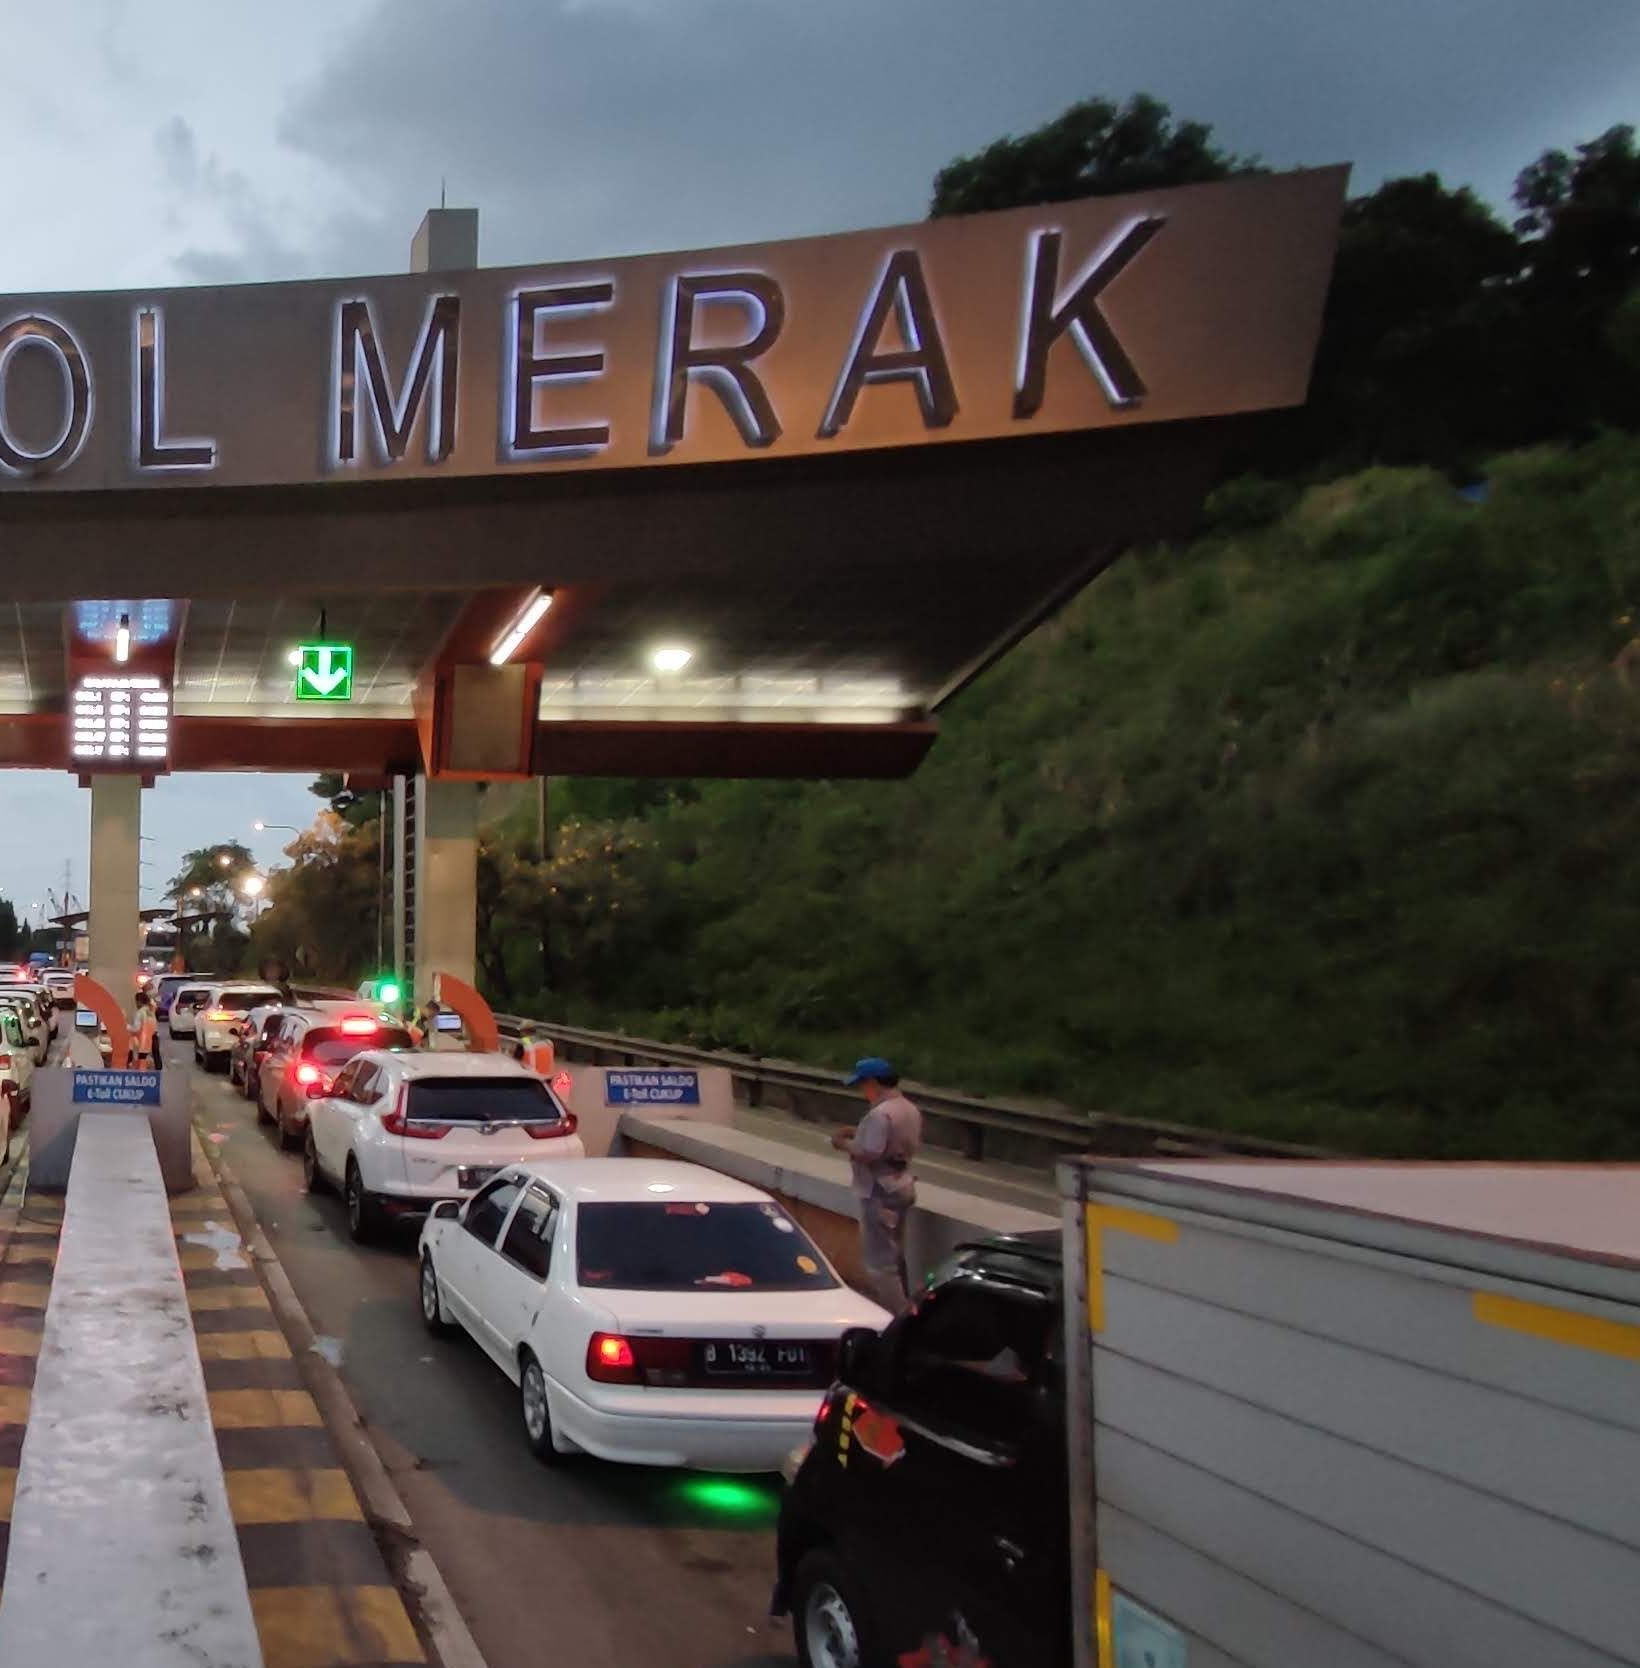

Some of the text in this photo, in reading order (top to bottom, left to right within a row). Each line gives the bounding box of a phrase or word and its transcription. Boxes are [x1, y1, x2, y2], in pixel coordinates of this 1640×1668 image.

[326, 214, 1168, 468] MERAK
[75, 1074, 157, 1088] PASTIKAN SALDO
[609, 1074, 695, 1087] PASTIKAN SALDO
[113, 1088, 145, 1100] CUKUP
[650, 1088, 684, 1100] CUKUP
